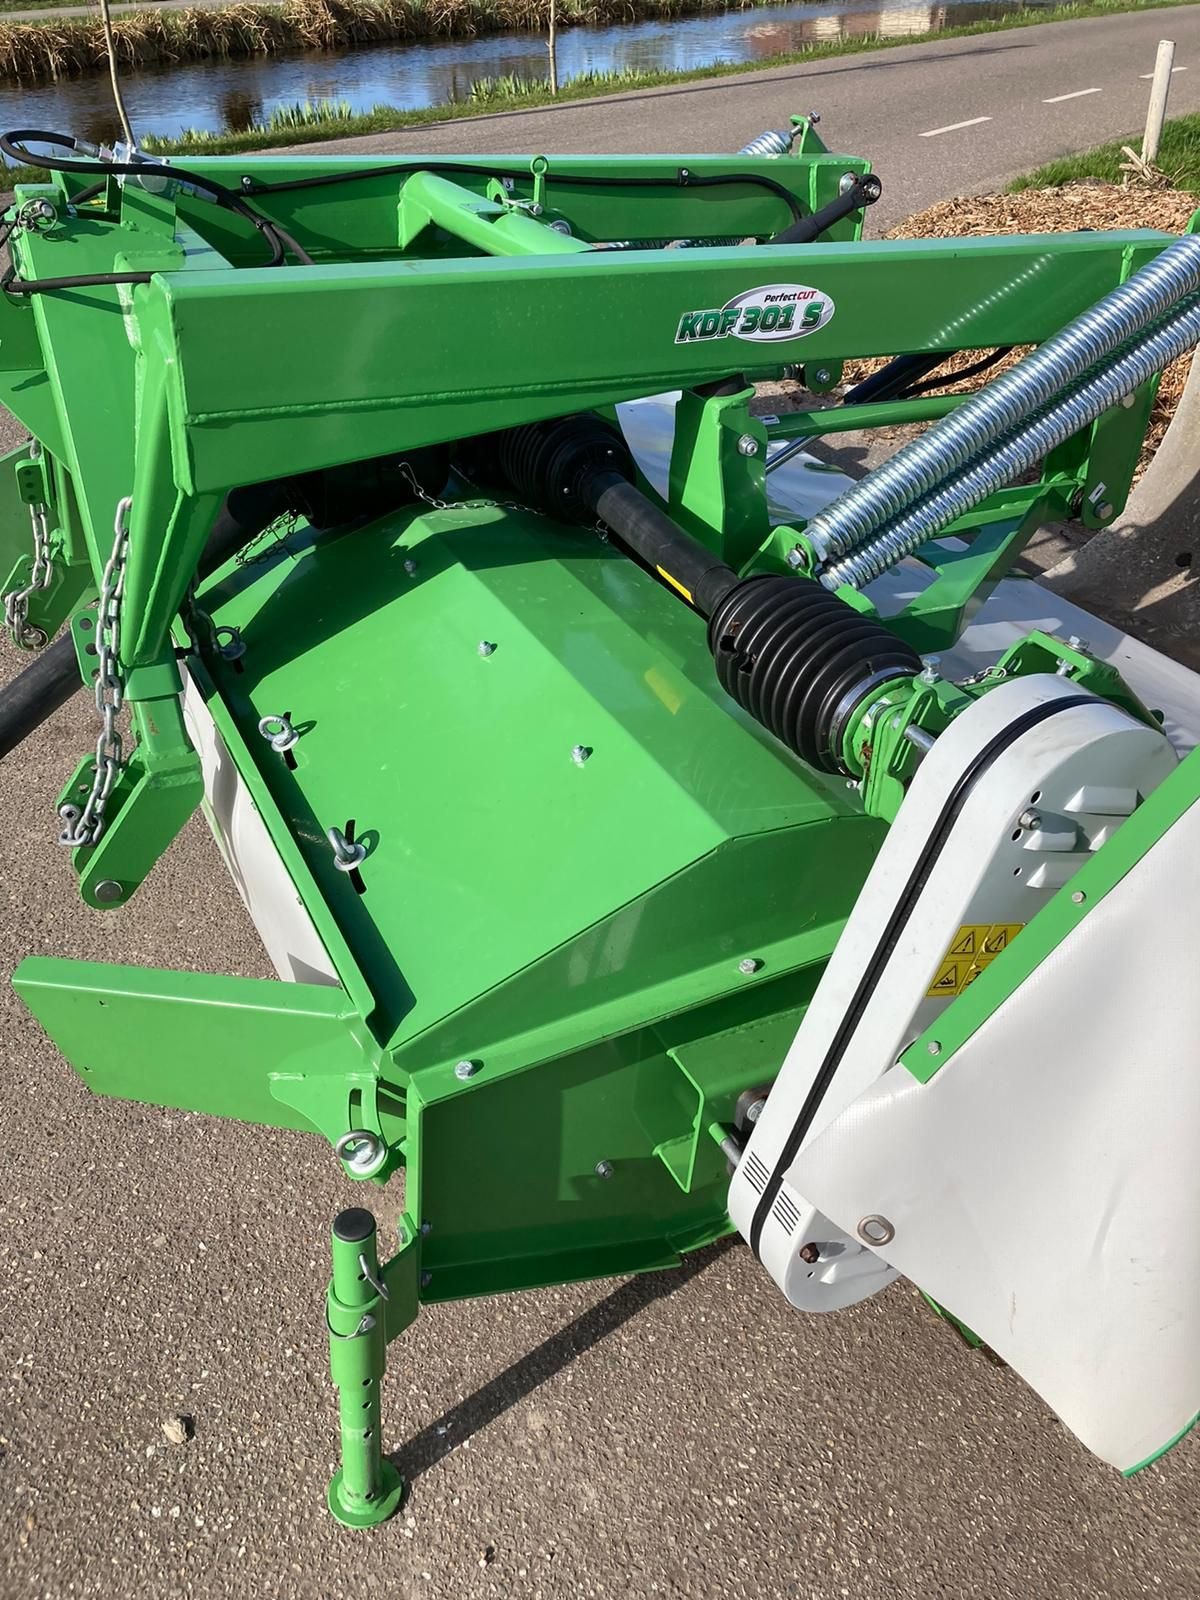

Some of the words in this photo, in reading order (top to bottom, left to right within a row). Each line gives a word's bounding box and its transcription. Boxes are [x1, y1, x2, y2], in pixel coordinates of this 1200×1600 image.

[676, 308, 741, 342] KDF
[738, 304, 796, 334] 301
[800, 301, 824, 329] S
